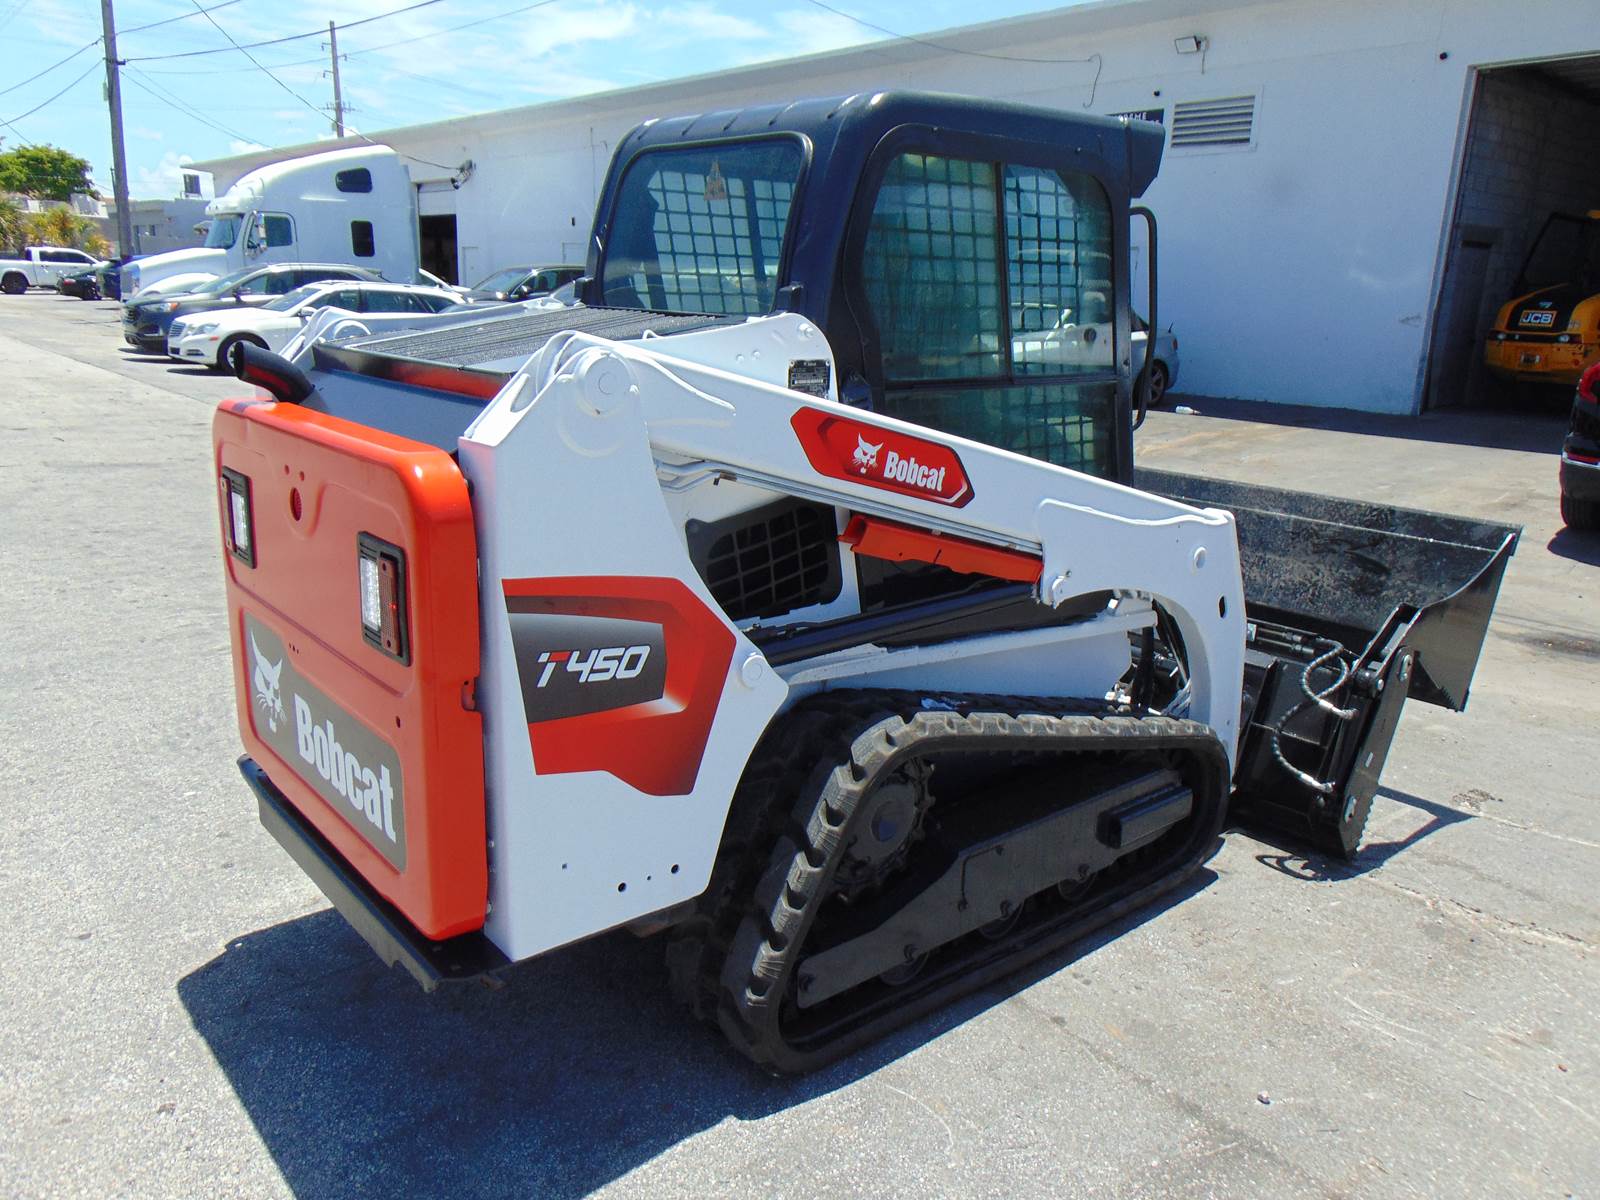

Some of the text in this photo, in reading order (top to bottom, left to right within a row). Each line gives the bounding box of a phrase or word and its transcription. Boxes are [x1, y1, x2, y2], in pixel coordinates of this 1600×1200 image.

[1522, 313, 1552, 324] JCB
[883, 451, 945, 492] Bobcat
[537, 645, 650, 688] T450
[294, 693, 397, 844] Bobcat
